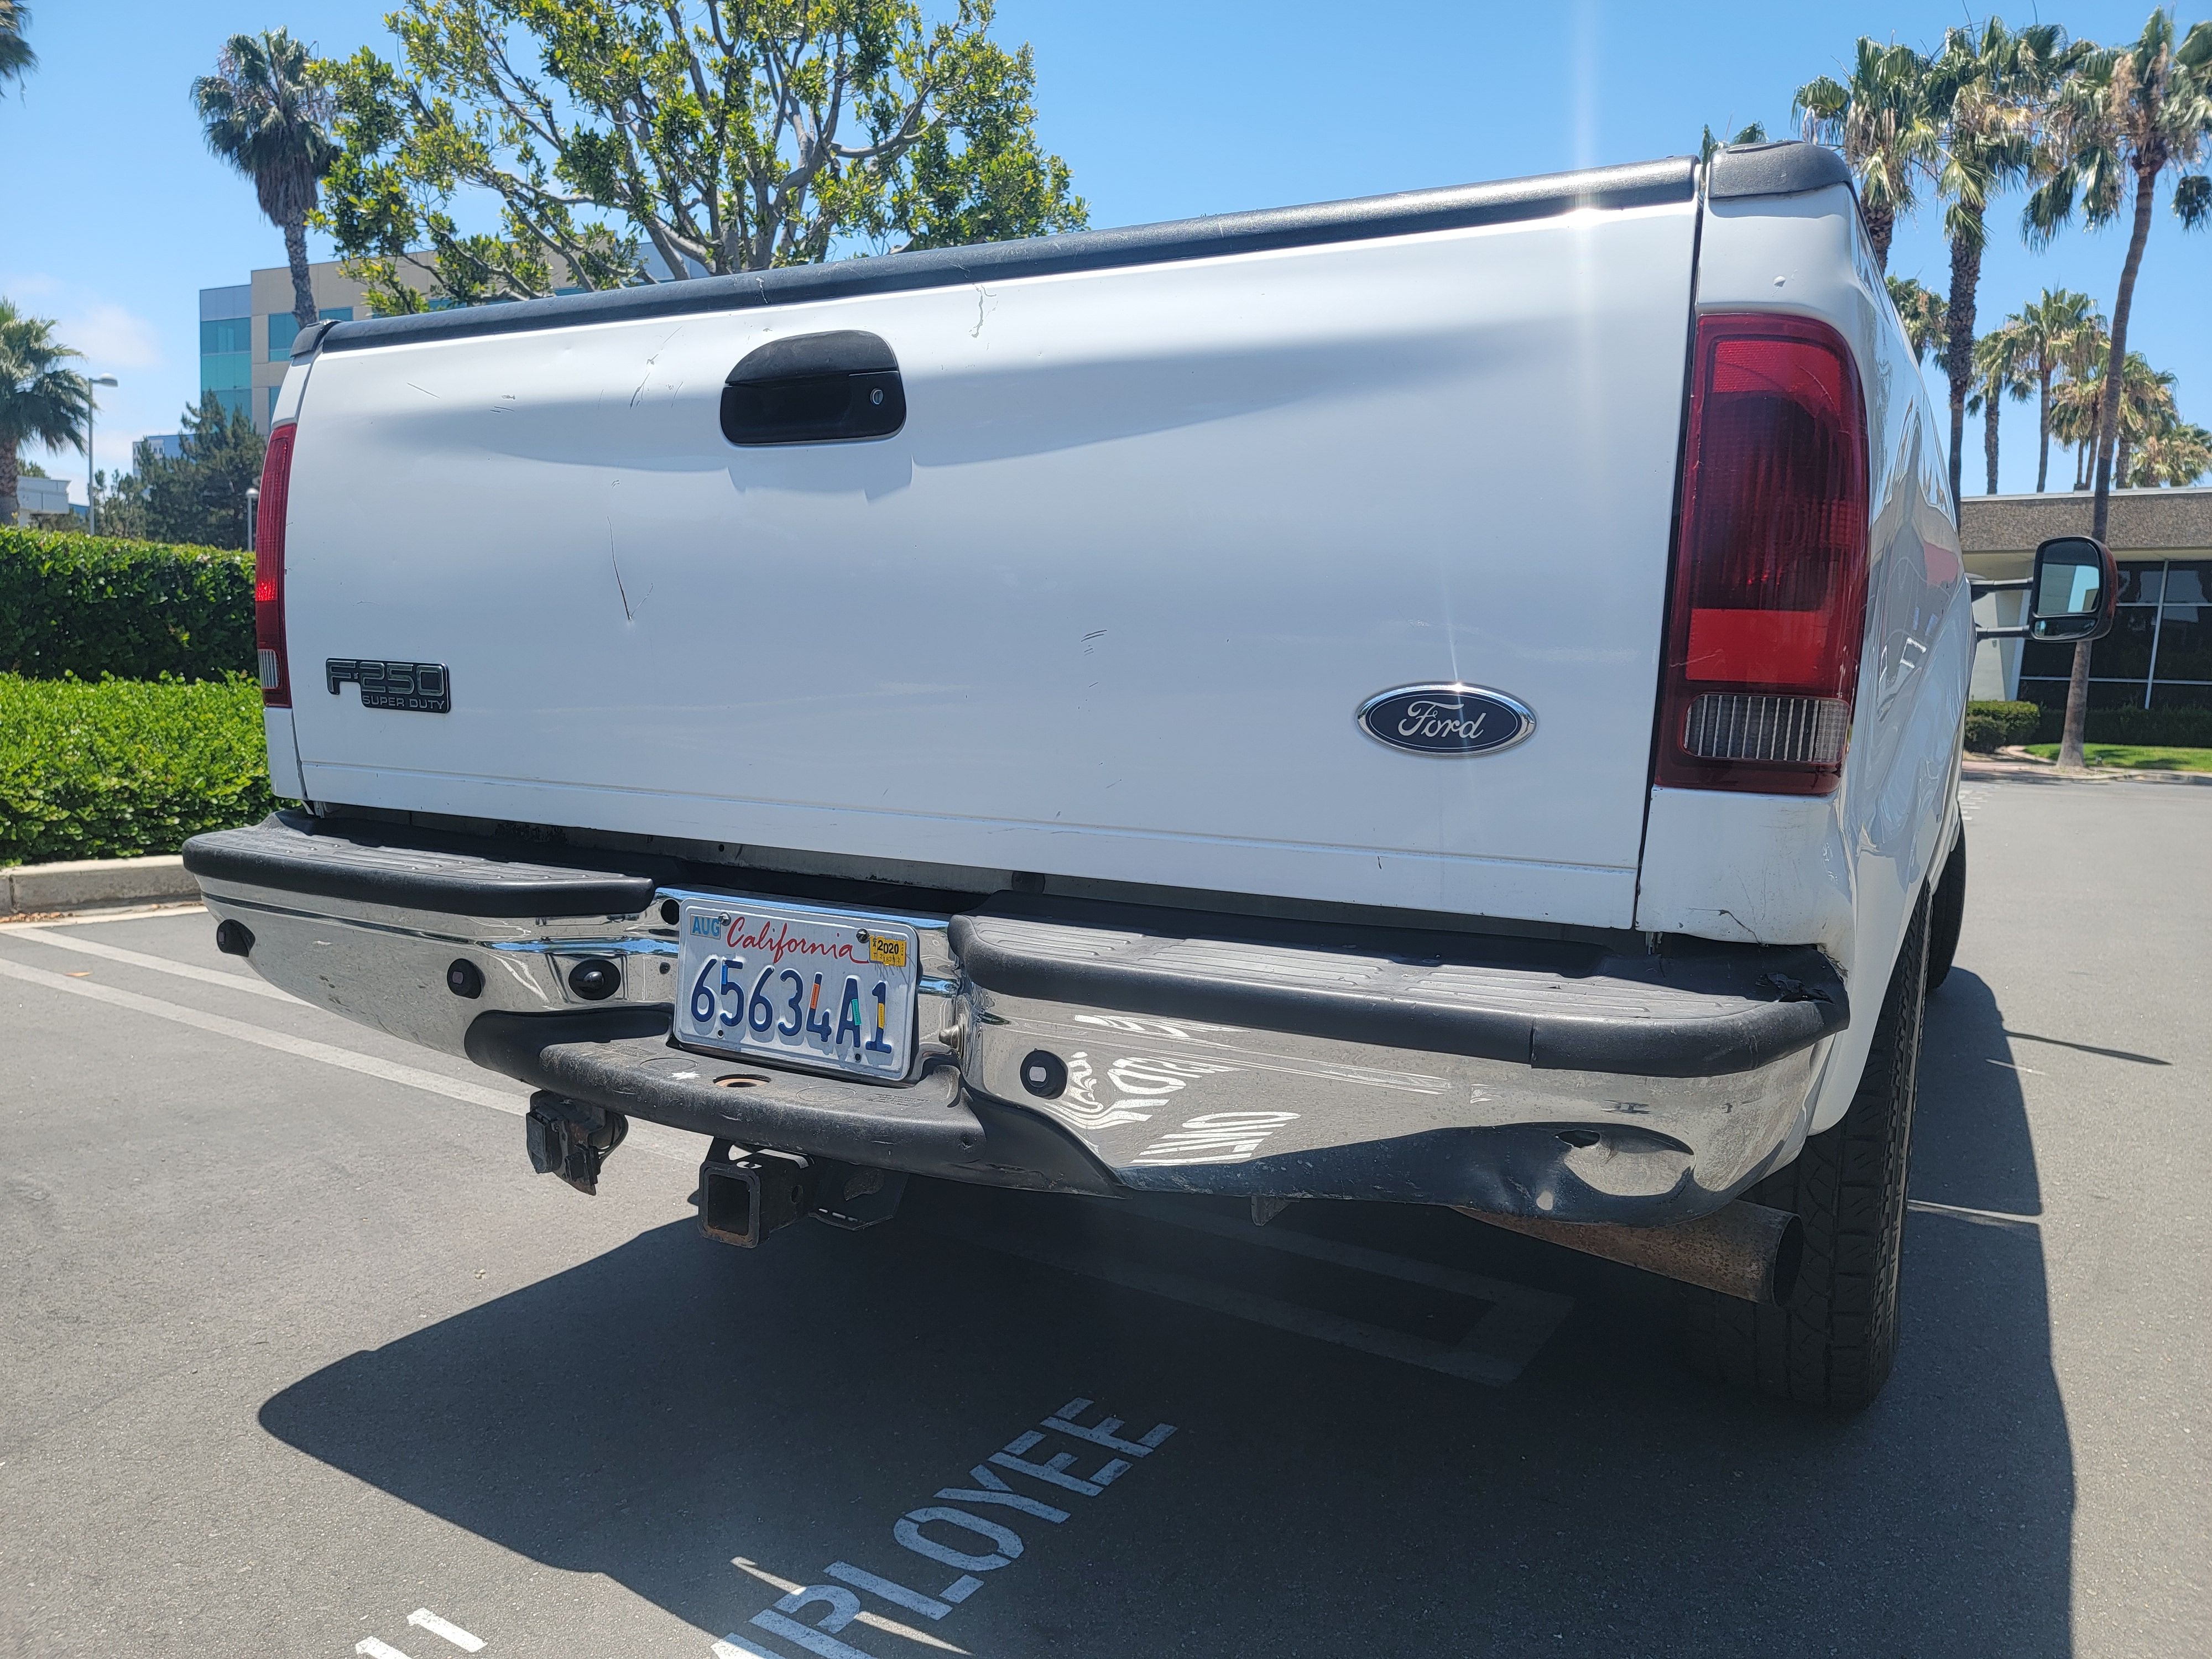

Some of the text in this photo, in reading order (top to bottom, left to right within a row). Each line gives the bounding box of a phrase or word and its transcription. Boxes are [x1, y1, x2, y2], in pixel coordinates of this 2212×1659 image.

[362, 695, 445, 709] SUPER DUTY
[1398, 700, 1487, 739] Ford
[692, 916, 719, 936] AUG
[727, 916, 870, 964] California
[877, 940, 899, 955] 2020
[691, 958, 893, 1054] 65634A1
